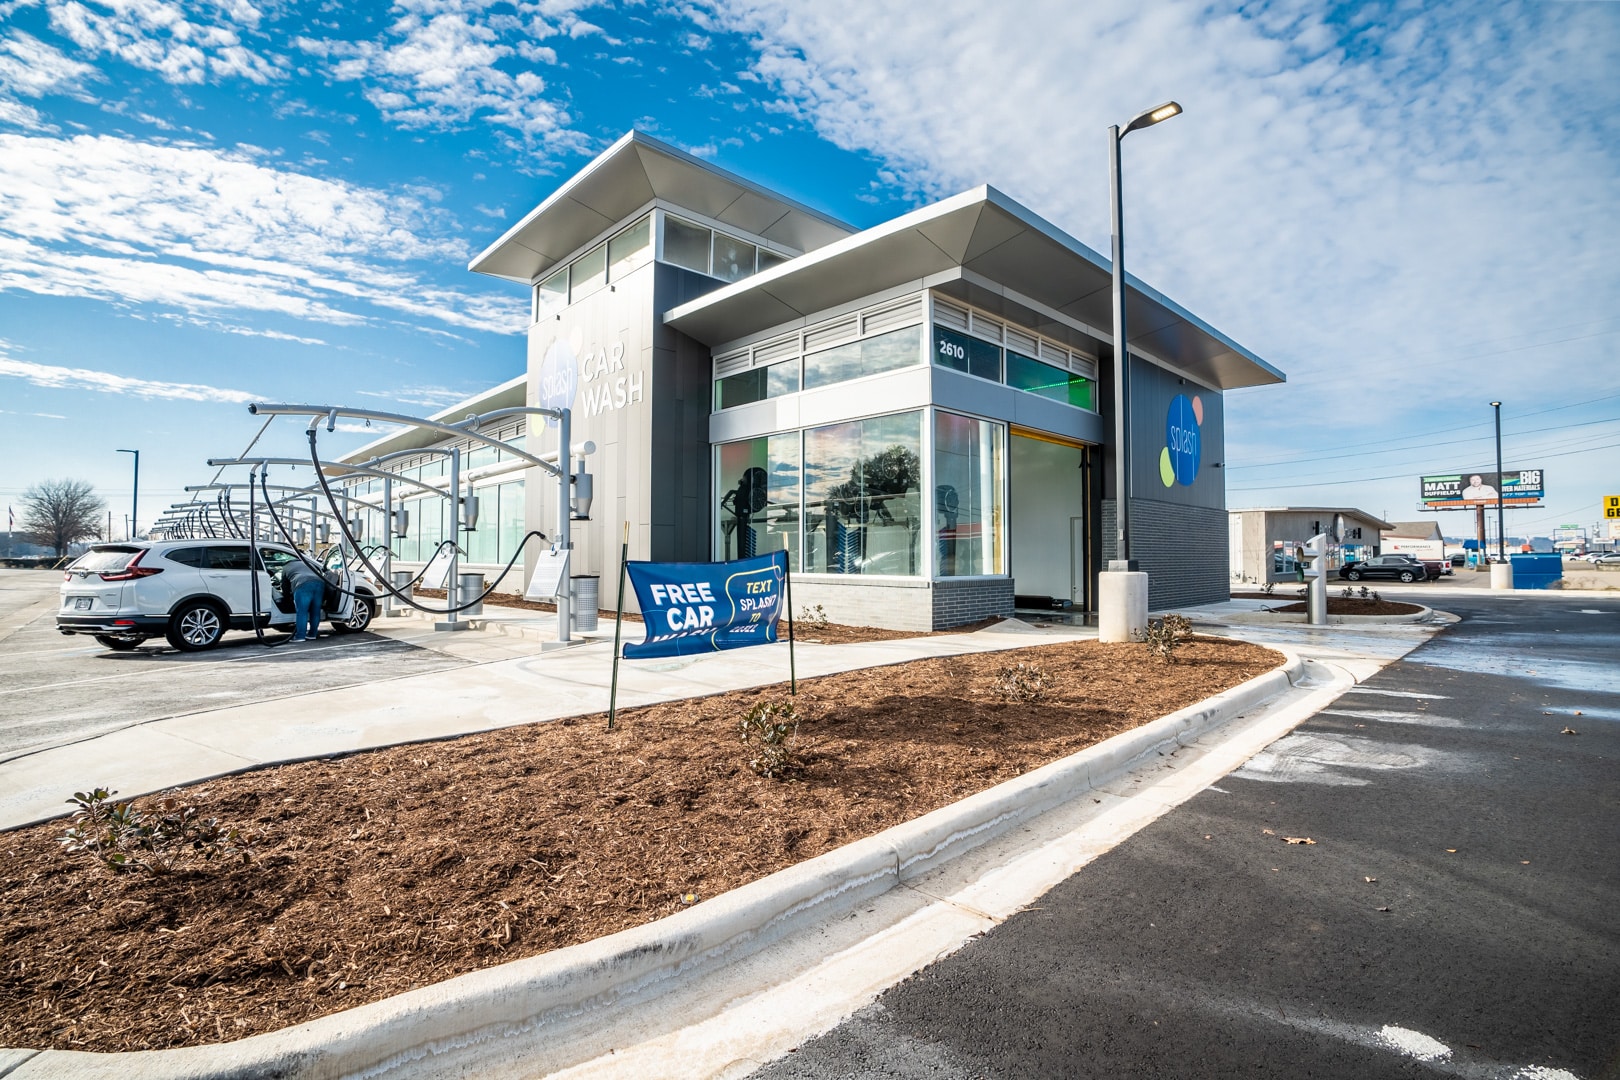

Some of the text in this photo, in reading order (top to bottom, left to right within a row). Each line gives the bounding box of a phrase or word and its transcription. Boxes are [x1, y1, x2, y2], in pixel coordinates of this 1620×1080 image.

[940, 341, 964, 359] 2610
[581, 340, 625, 383] CAR
[581, 371, 644, 418] WASH
[1520, 470, 1540, 484] BIG
[1424, 481, 1460, 492] MATT
[650, 582, 717, 606] FREE
[746, 579, 773, 594] TEXT
[666, 605, 715, 632] CAR
[749, 612, 761, 623] TO
